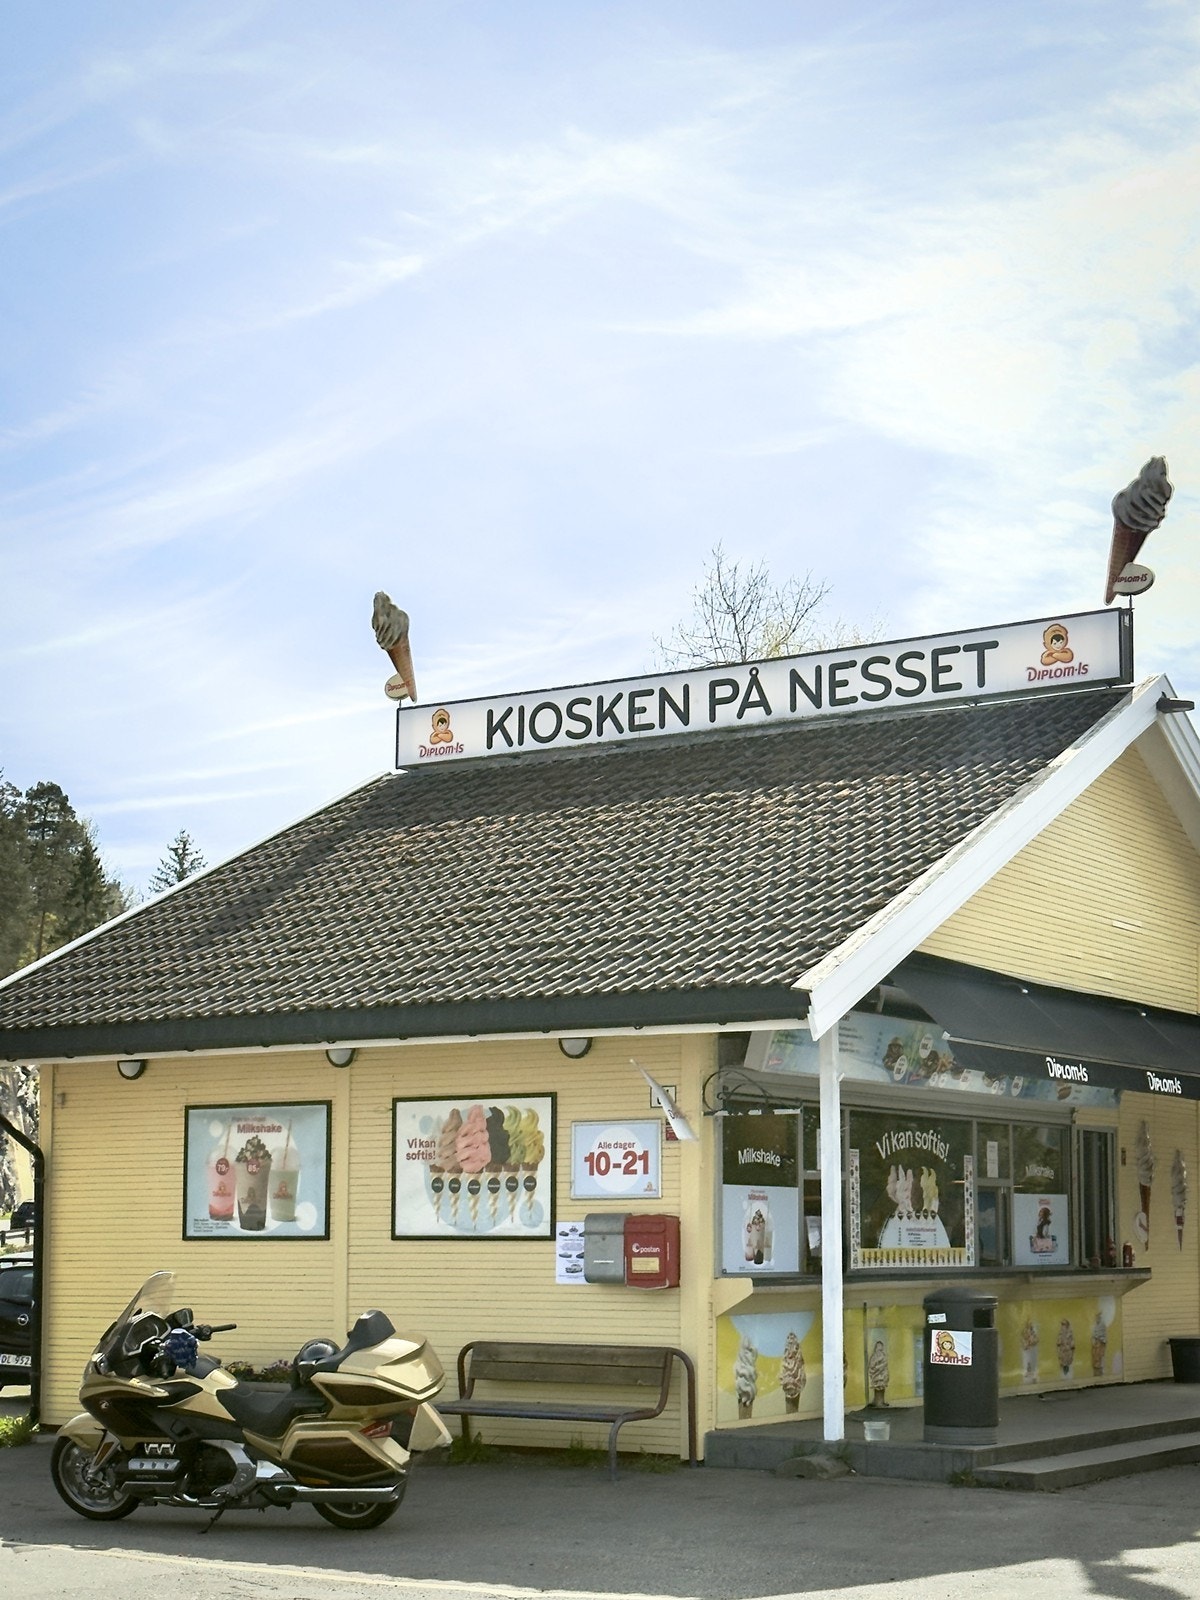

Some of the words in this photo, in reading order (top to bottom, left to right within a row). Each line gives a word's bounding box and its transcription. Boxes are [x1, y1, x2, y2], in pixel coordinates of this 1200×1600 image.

[487, 683, 690, 750] KIOSKEN
[709, 666, 772, 723] PÅ
[789, 640, 999, 713] NESSET
[237, 1124, 283, 1133] Milkshake
[407, 1138, 417, 1148] Vi
[418, 1138, 436, 1148] kan
[597, 1141, 612, 1149] Alle
[613, 1141, 636, 1150] dager
[875, 1133, 891, 1159] Vi
[890, 1130, 913, 1153] kan
[915, 1129, 950, 1162] softis!
[406, 1150, 436, 1161] softis!
[584, 1150, 649, 1176] 10-21
[738, 1147, 781, 1167] Milkshake
